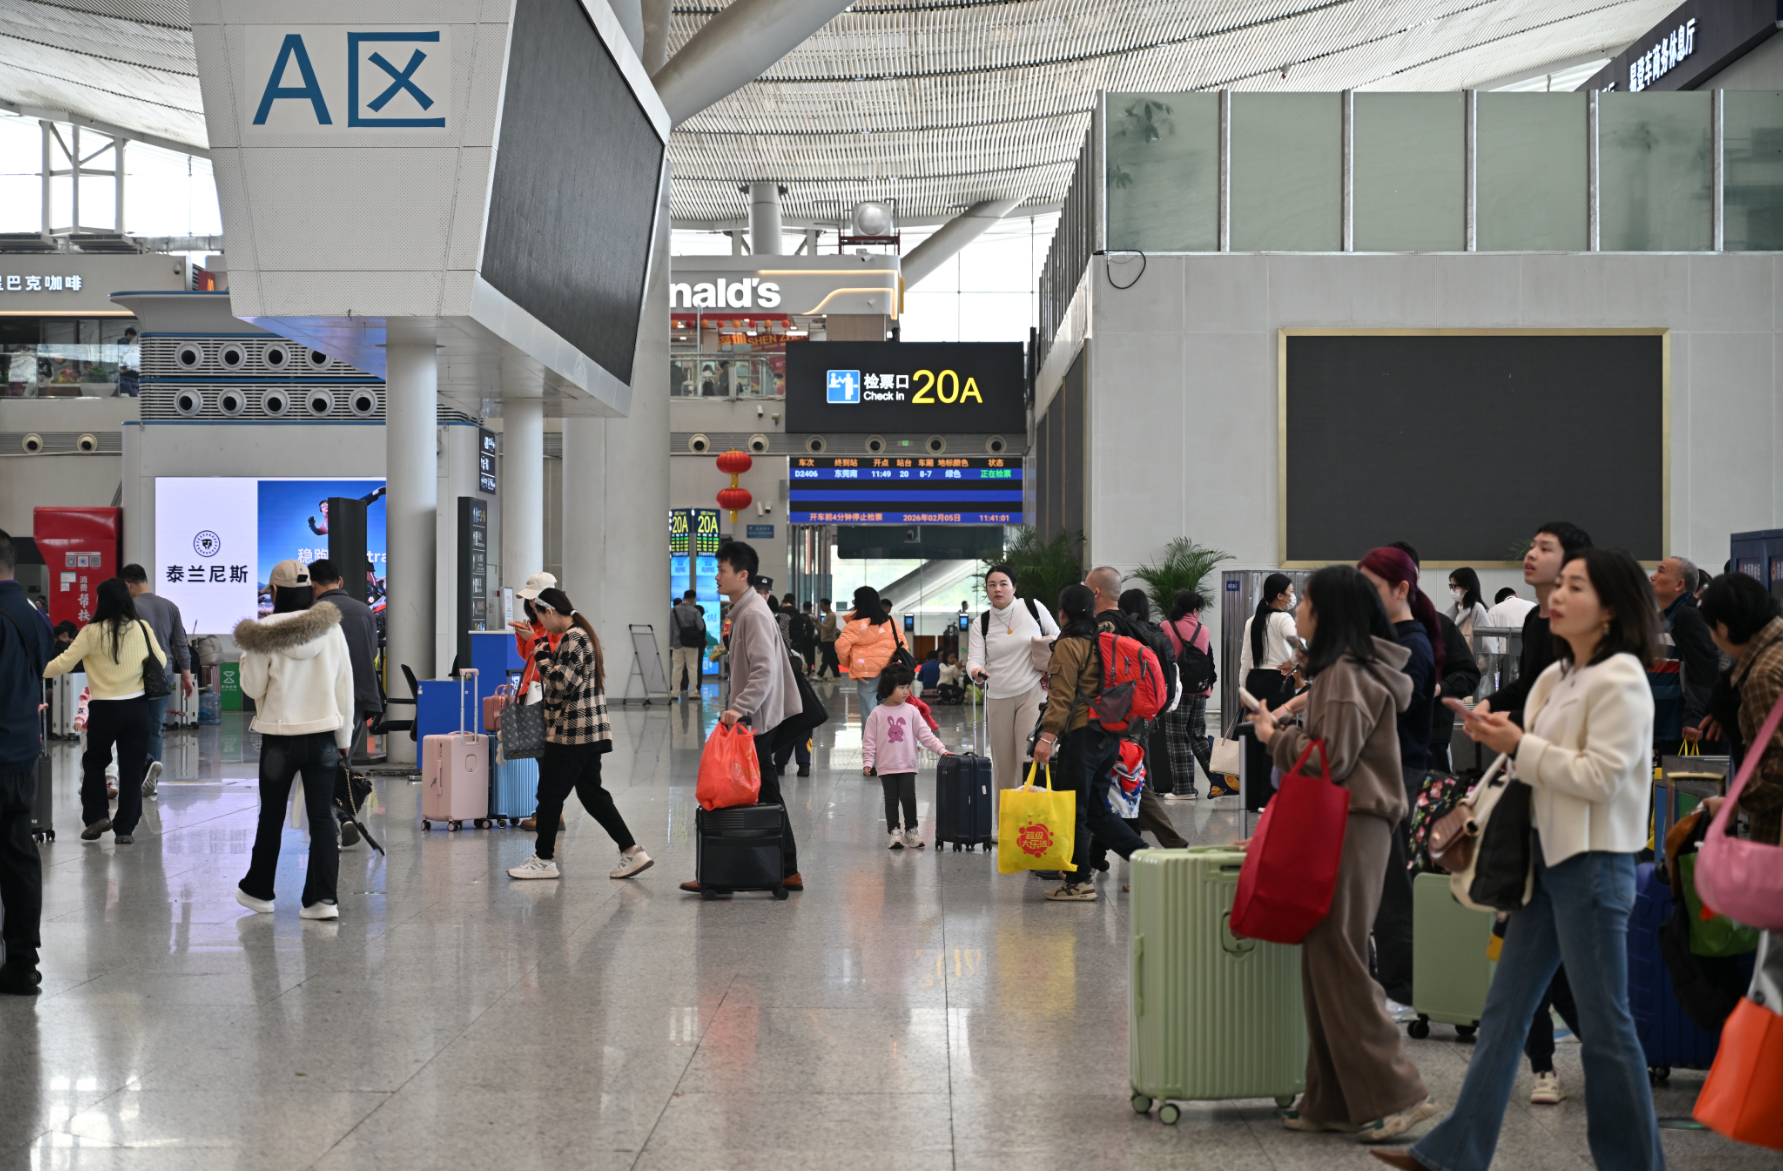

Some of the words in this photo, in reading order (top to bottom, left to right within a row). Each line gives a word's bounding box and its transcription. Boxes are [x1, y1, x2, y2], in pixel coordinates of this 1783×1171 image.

[252, 30, 446, 128] A区
[0, 274, 82, 291] 巴克咖啡
[748, 335, 777, 346] SHEN
[863, 373, 909, 389] 检票口
[912, 369, 983, 404] 20A
[863, 391, 894, 401] Check
[798, 458, 815, 467] 车次
[834, 458, 858, 467] 终到站
[873, 458, 889, 467] 开点
[896, 458, 912, 467] 站台
[918, 458, 934, 467] 车厢
[937, 458, 969, 467] 地标颜色
[988, 458, 1004, 467] 状态
[794, 470, 818, 478] D2406
[834, 469, 858, 478] 东莞南
[871, 470, 892, 478] 11:49
[899, 470, 909, 478] 20
[945, 469, 961, 478] 绿色
[980, 469, 1012, 478] 正在检票
[672, 515, 689, 533] 20A
[697, 515, 719, 533] 20A
[809, 513, 883, 522] 开车前4分钟停止检票
[902, 513, 961, 522] 2026年02月05日
[979, 514, 1010, 522] 11:41:01
[166, 564, 248, 584] 泰兰尼斯
[1025, 831, 1044, 840] 超级
